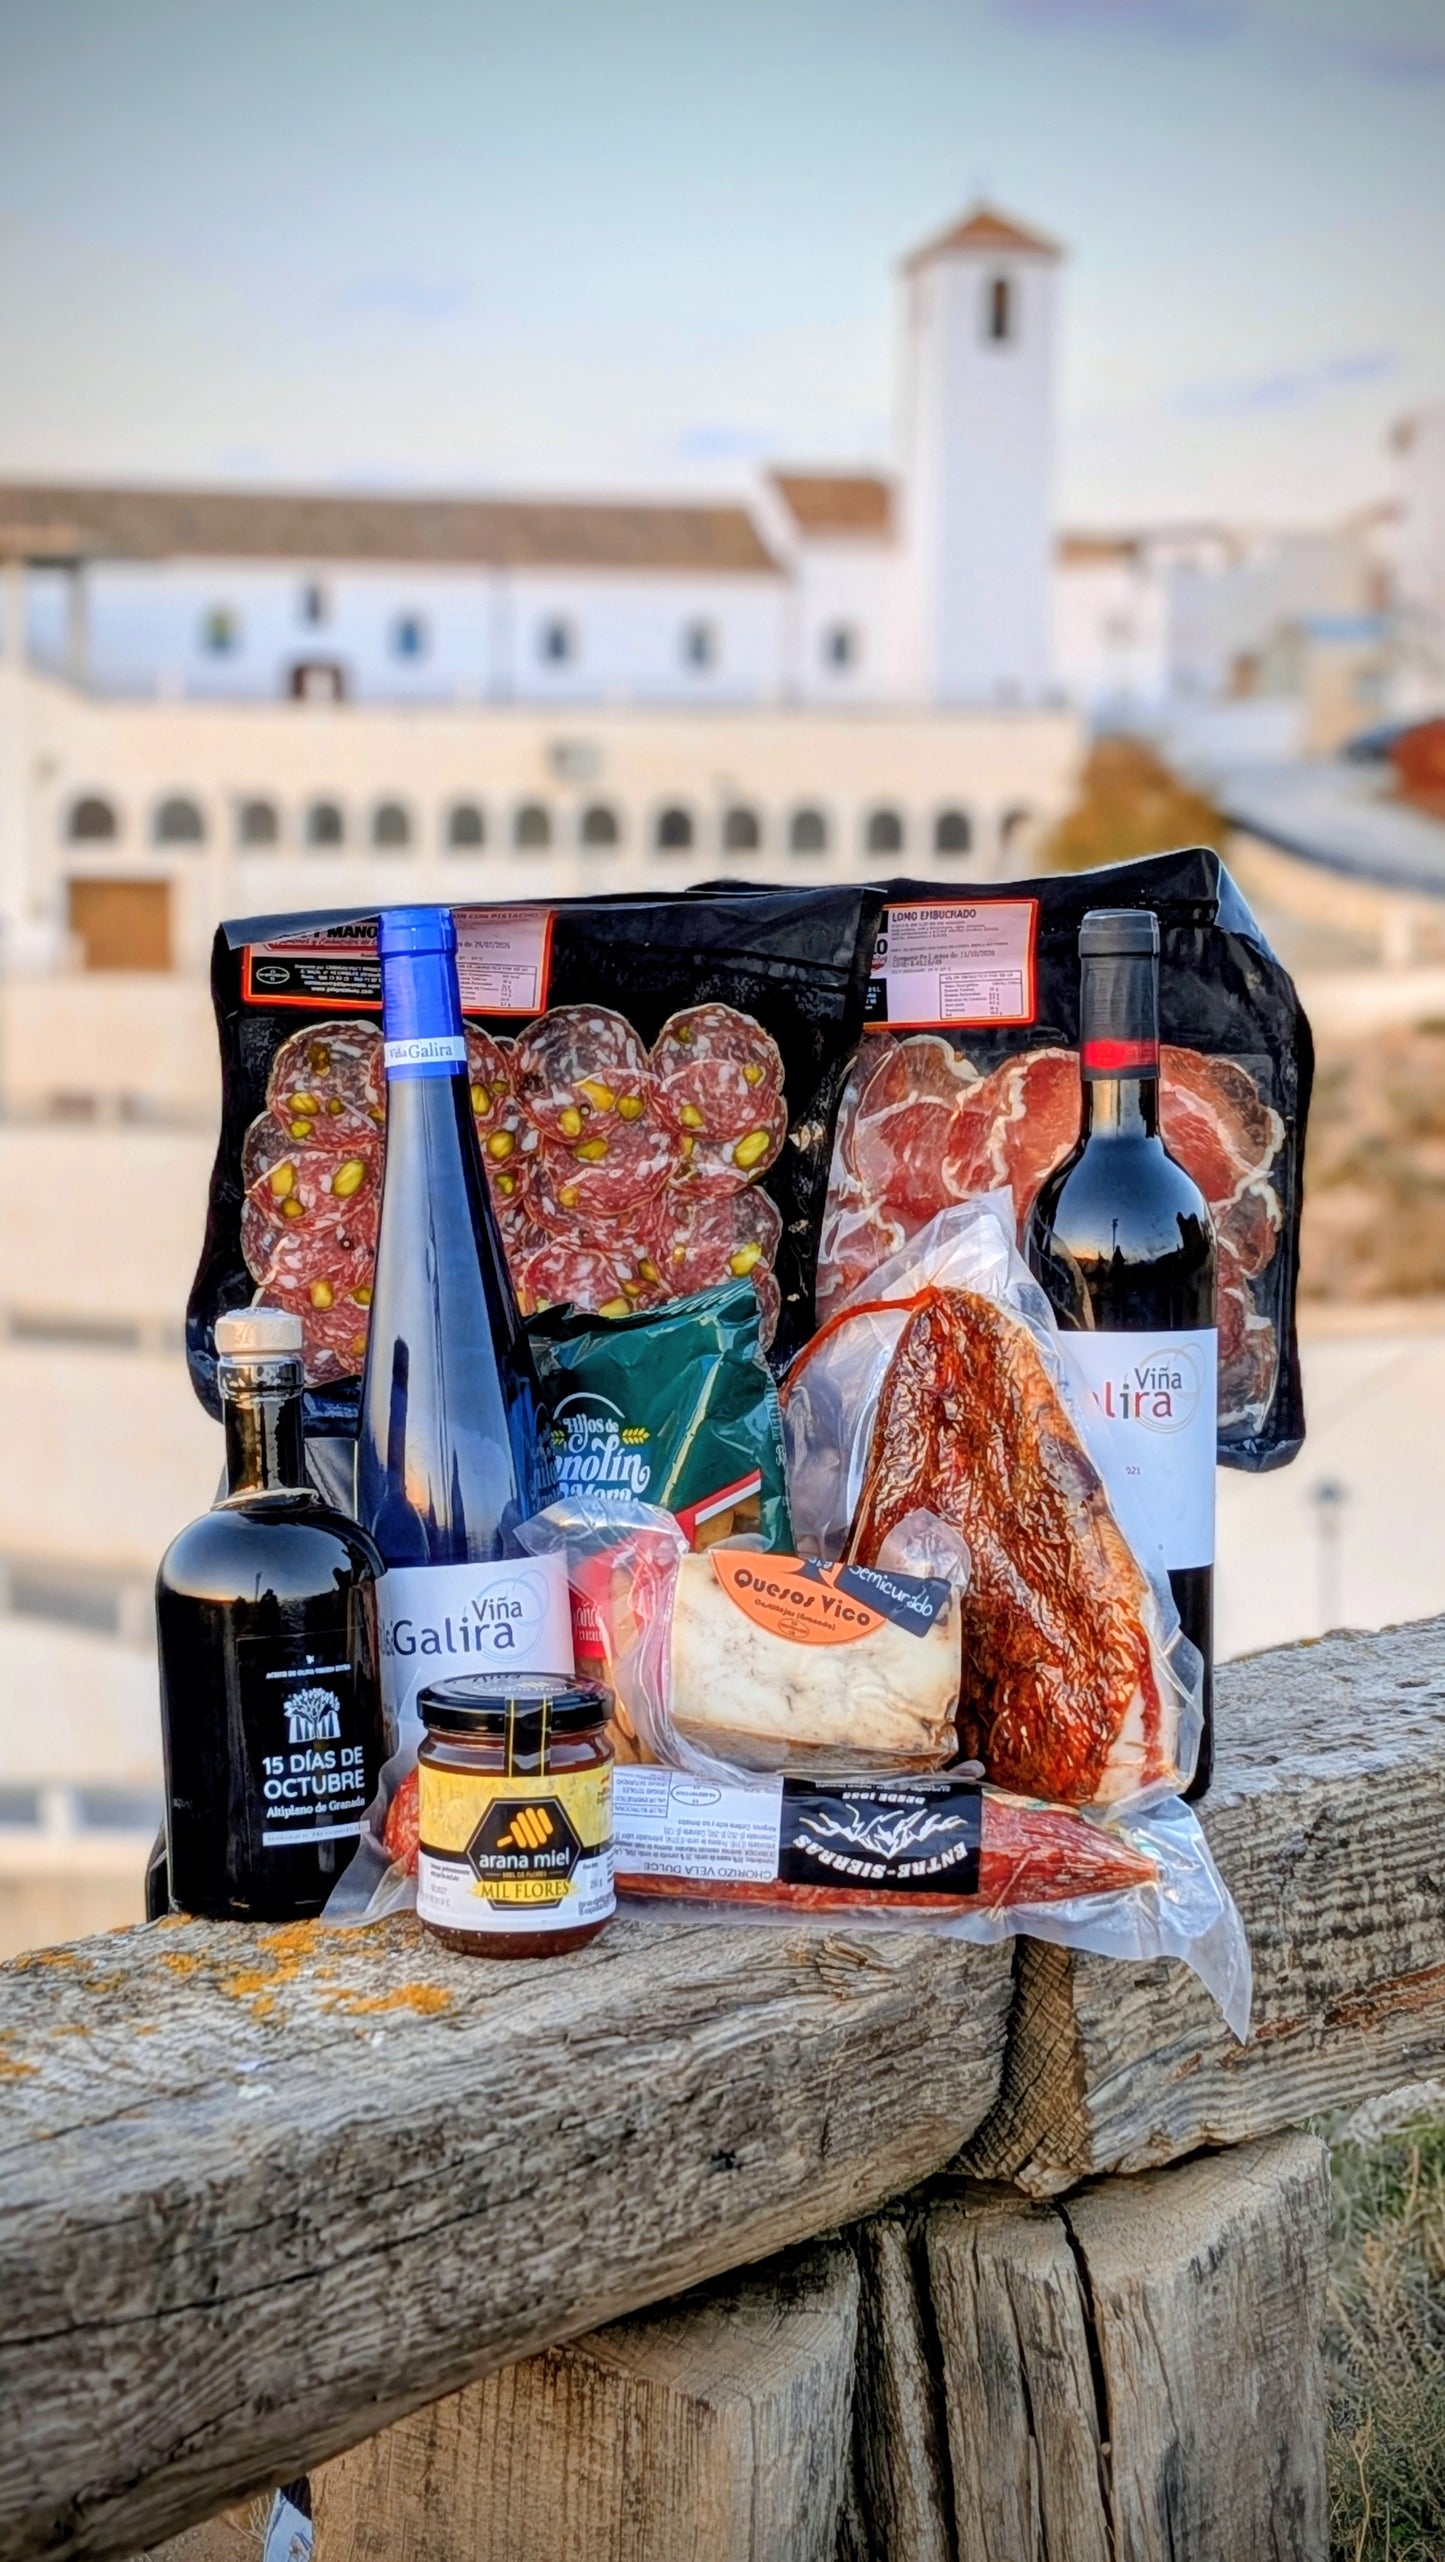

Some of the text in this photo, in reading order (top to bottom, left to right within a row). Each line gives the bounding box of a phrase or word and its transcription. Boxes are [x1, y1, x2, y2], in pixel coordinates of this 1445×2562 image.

[892, 911, 918, 922] LOMO
[408, 1042, 453, 1058] Galira
[1134, 1367, 1183, 1390] Viña
[1092, 1381, 1173, 1419] lira
[563, 1413, 620, 1453] Hijos de
[733, 1568, 871, 1627] Quesos Vico
[849, 1565, 934, 1618] Semicurado
[472, 1596, 523, 1622] Viña
[393, 1617, 516, 1656] Galira
[262, 1746, 364, 1775] 15 DÍAS DE
[263, 1769, 365, 1800] OCTUBRE
[315, 1801, 327, 1813] de
[328, 1795, 365, 1810] Granada
[878, 1793, 926, 1805] DESDE
[478, 1847, 570, 1869] arana miel
[792, 1834, 968, 1879] ENTRE-SIERRAS
[643, 1862, 772, 1879] CHORIZO VELA DULCE
[480, 1882, 510, 1899] MIL
[514, 1880, 570, 1899] FLORES
